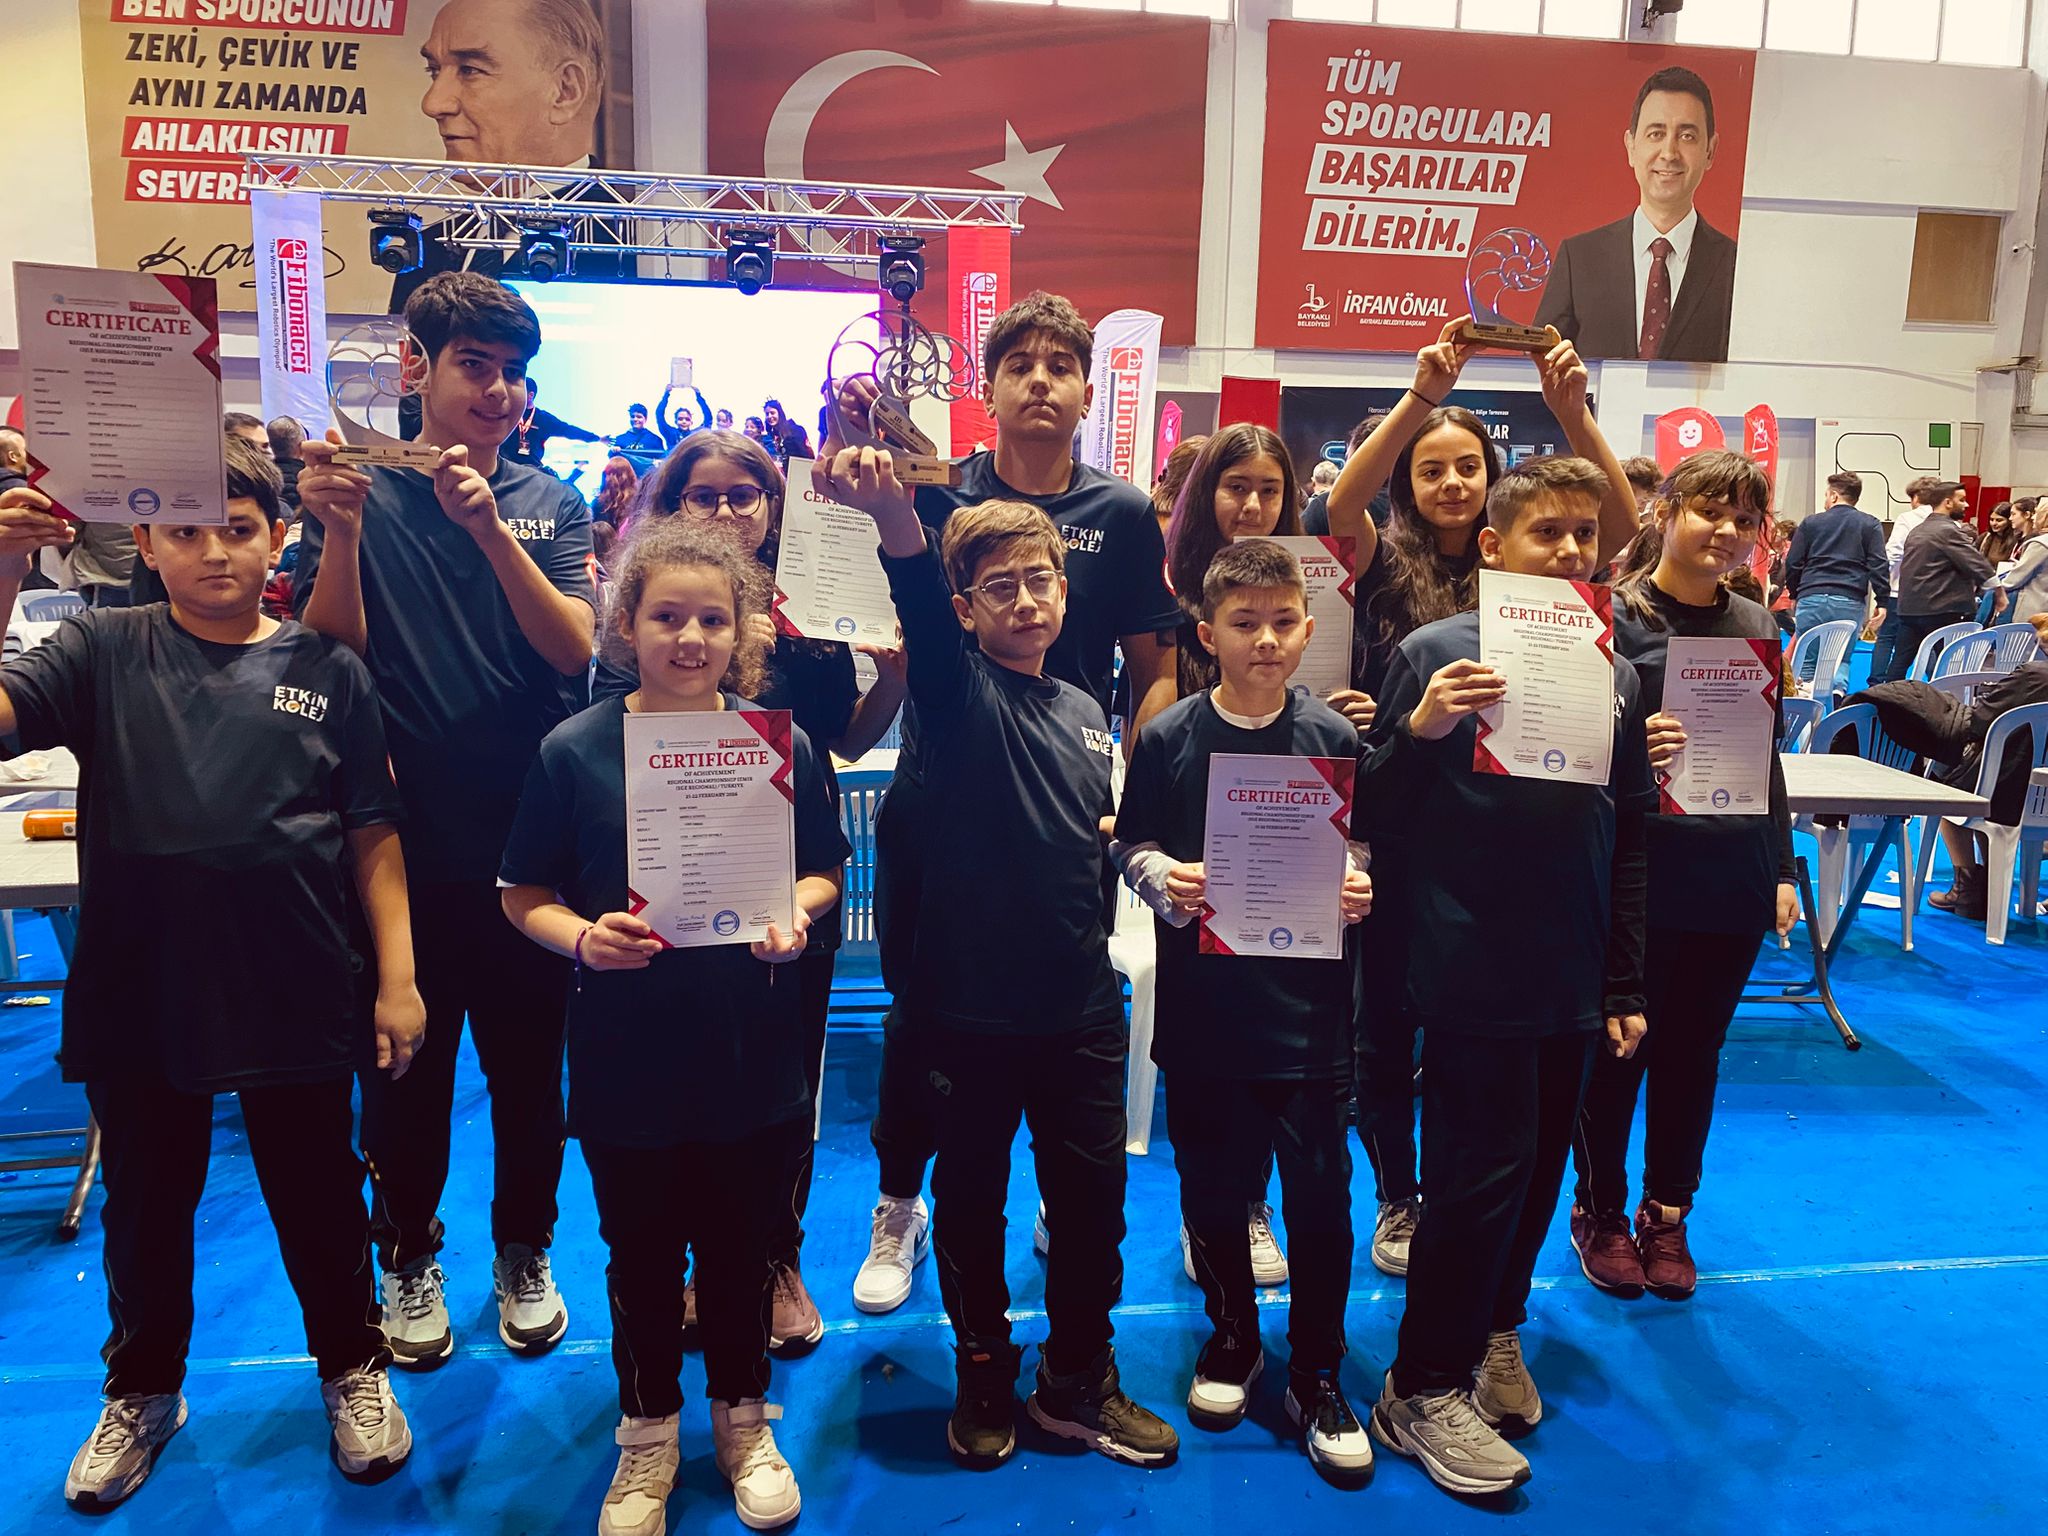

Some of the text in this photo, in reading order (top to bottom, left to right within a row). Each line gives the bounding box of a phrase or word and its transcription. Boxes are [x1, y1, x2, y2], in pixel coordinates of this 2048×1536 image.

[122, 0, 393, 29] BEN SPORCUNUN
[125, 27, 360, 72] ZEKİ, ÇEVİK VE
[1326, 49, 1401, 96] TÜM
[128, 77, 367, 115] AYNI ZAMANDA
[131, 121, 335, 154] AHLAKLISINI
[1321, 100, 1551, 148] SPORCULARA
[1319, 151, 1516, 194] BAŞARILAR
[1314, 203, 1466, 252] DİLERİM.
[271, 281, 279, 307] Largest
[1343, 290, 1449, 318] İRFAN ÖNAL
[46, 309, 192, 335] CERTIFICATE
[272, 308, 280, 336] Robotics
[286, 260, 311, 374] Fibonacci
[1099, 396, 1107, 425] Largest
[1499, 606, 1594, 629] CERTIFICATE
[1681, 668, 1763, 680] CERTIFICATE
[649, 751, 769, 769] CERTIFICATE
[1227, 789, 1331, 805] CERTIFICATE
